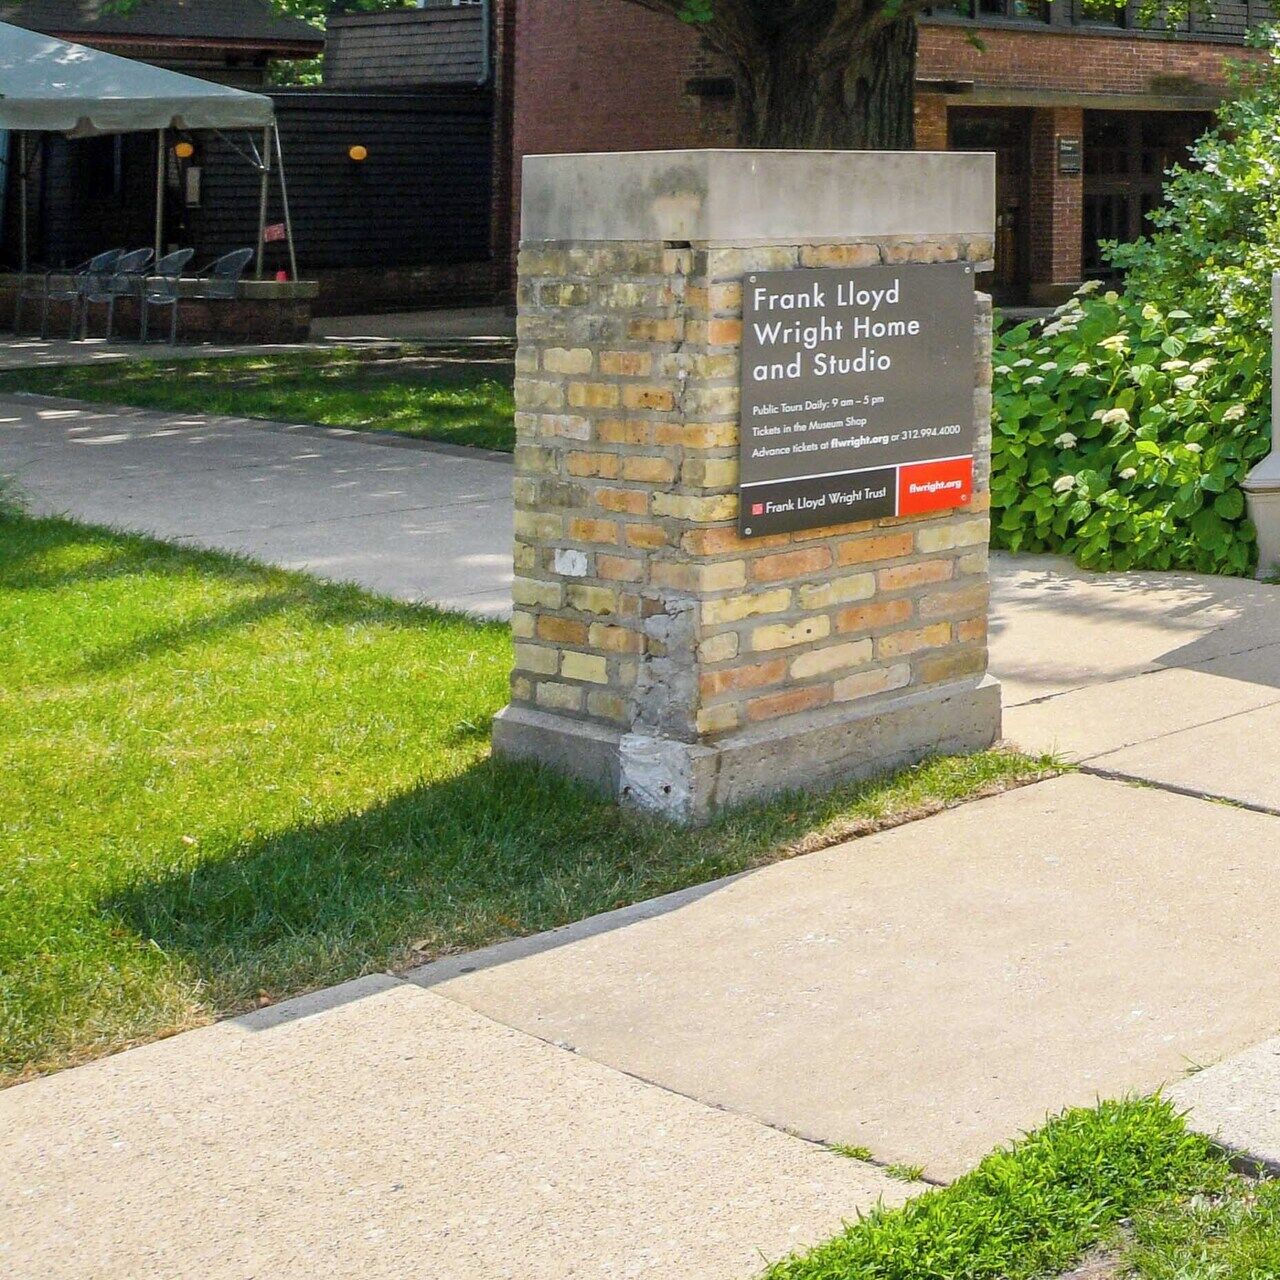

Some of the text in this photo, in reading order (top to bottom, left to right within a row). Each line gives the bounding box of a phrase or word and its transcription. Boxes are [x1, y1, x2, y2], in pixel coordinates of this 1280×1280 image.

[755, 278, 899, 311] Frank Lloyd
[753, 316, 920, 349] Wright Home
[754, 347, 890, 381] and Studio
[753, 394, 884, 416] Public Tours Daily: 9 am 5 pm
[751, 446, 791, 458] Advance
[792, 442, 819, 453] tickets
[820, 441, 829, 450] at
[890, 434, 900, 442] or
[901, 424, 961, 440] 312.994.4000
[753, 416, 867, 437] Tickets in the Museum Shop
[766, 486, 886, 514] Frank Lloyd Wright Trust
